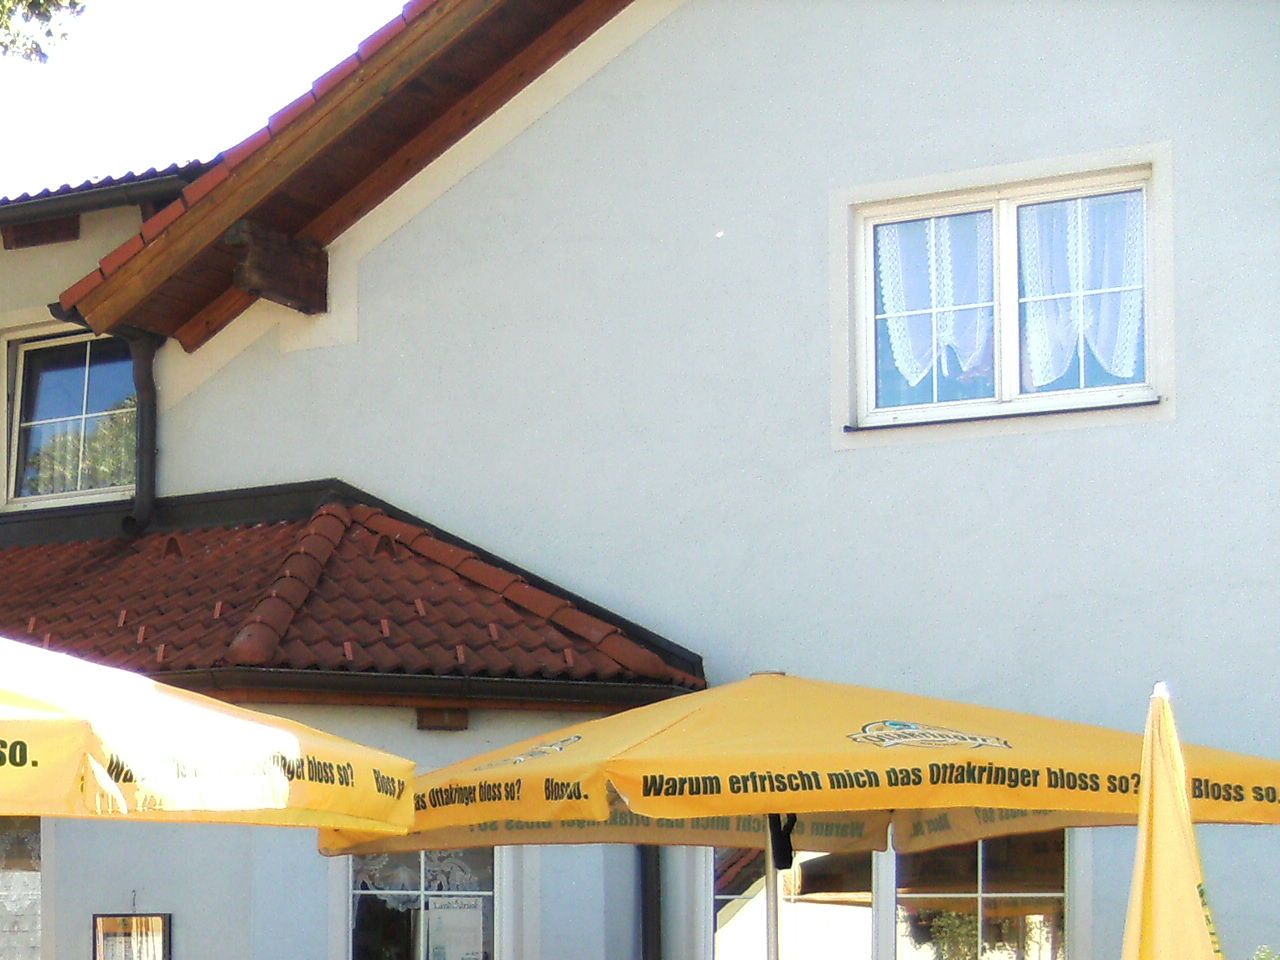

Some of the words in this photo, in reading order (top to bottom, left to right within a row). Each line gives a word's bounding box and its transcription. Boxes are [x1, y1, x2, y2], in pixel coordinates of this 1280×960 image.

[306, 755, 335, 785] bloss
[337, 762, 355, 788] so?
[373, 768, 397, 799] Bloss
[642, 774, 721, 797] Warum
[729, 770, 822, 793] erfrischt
[829, 767, 880, 789] mich
[887, 765, 923, 787] das
[929, 761, 1040, 788] Ottakringer
[1047, 766, 1100, 792] bloss
[1108, 773, 1140, 795] so?
[429, 784, 477, 808] Ottakringer
[479, 780, 502, 802] bloss
[504, 778, 522, 801] so?
[1192, 778, 1244, 802] Bloss
